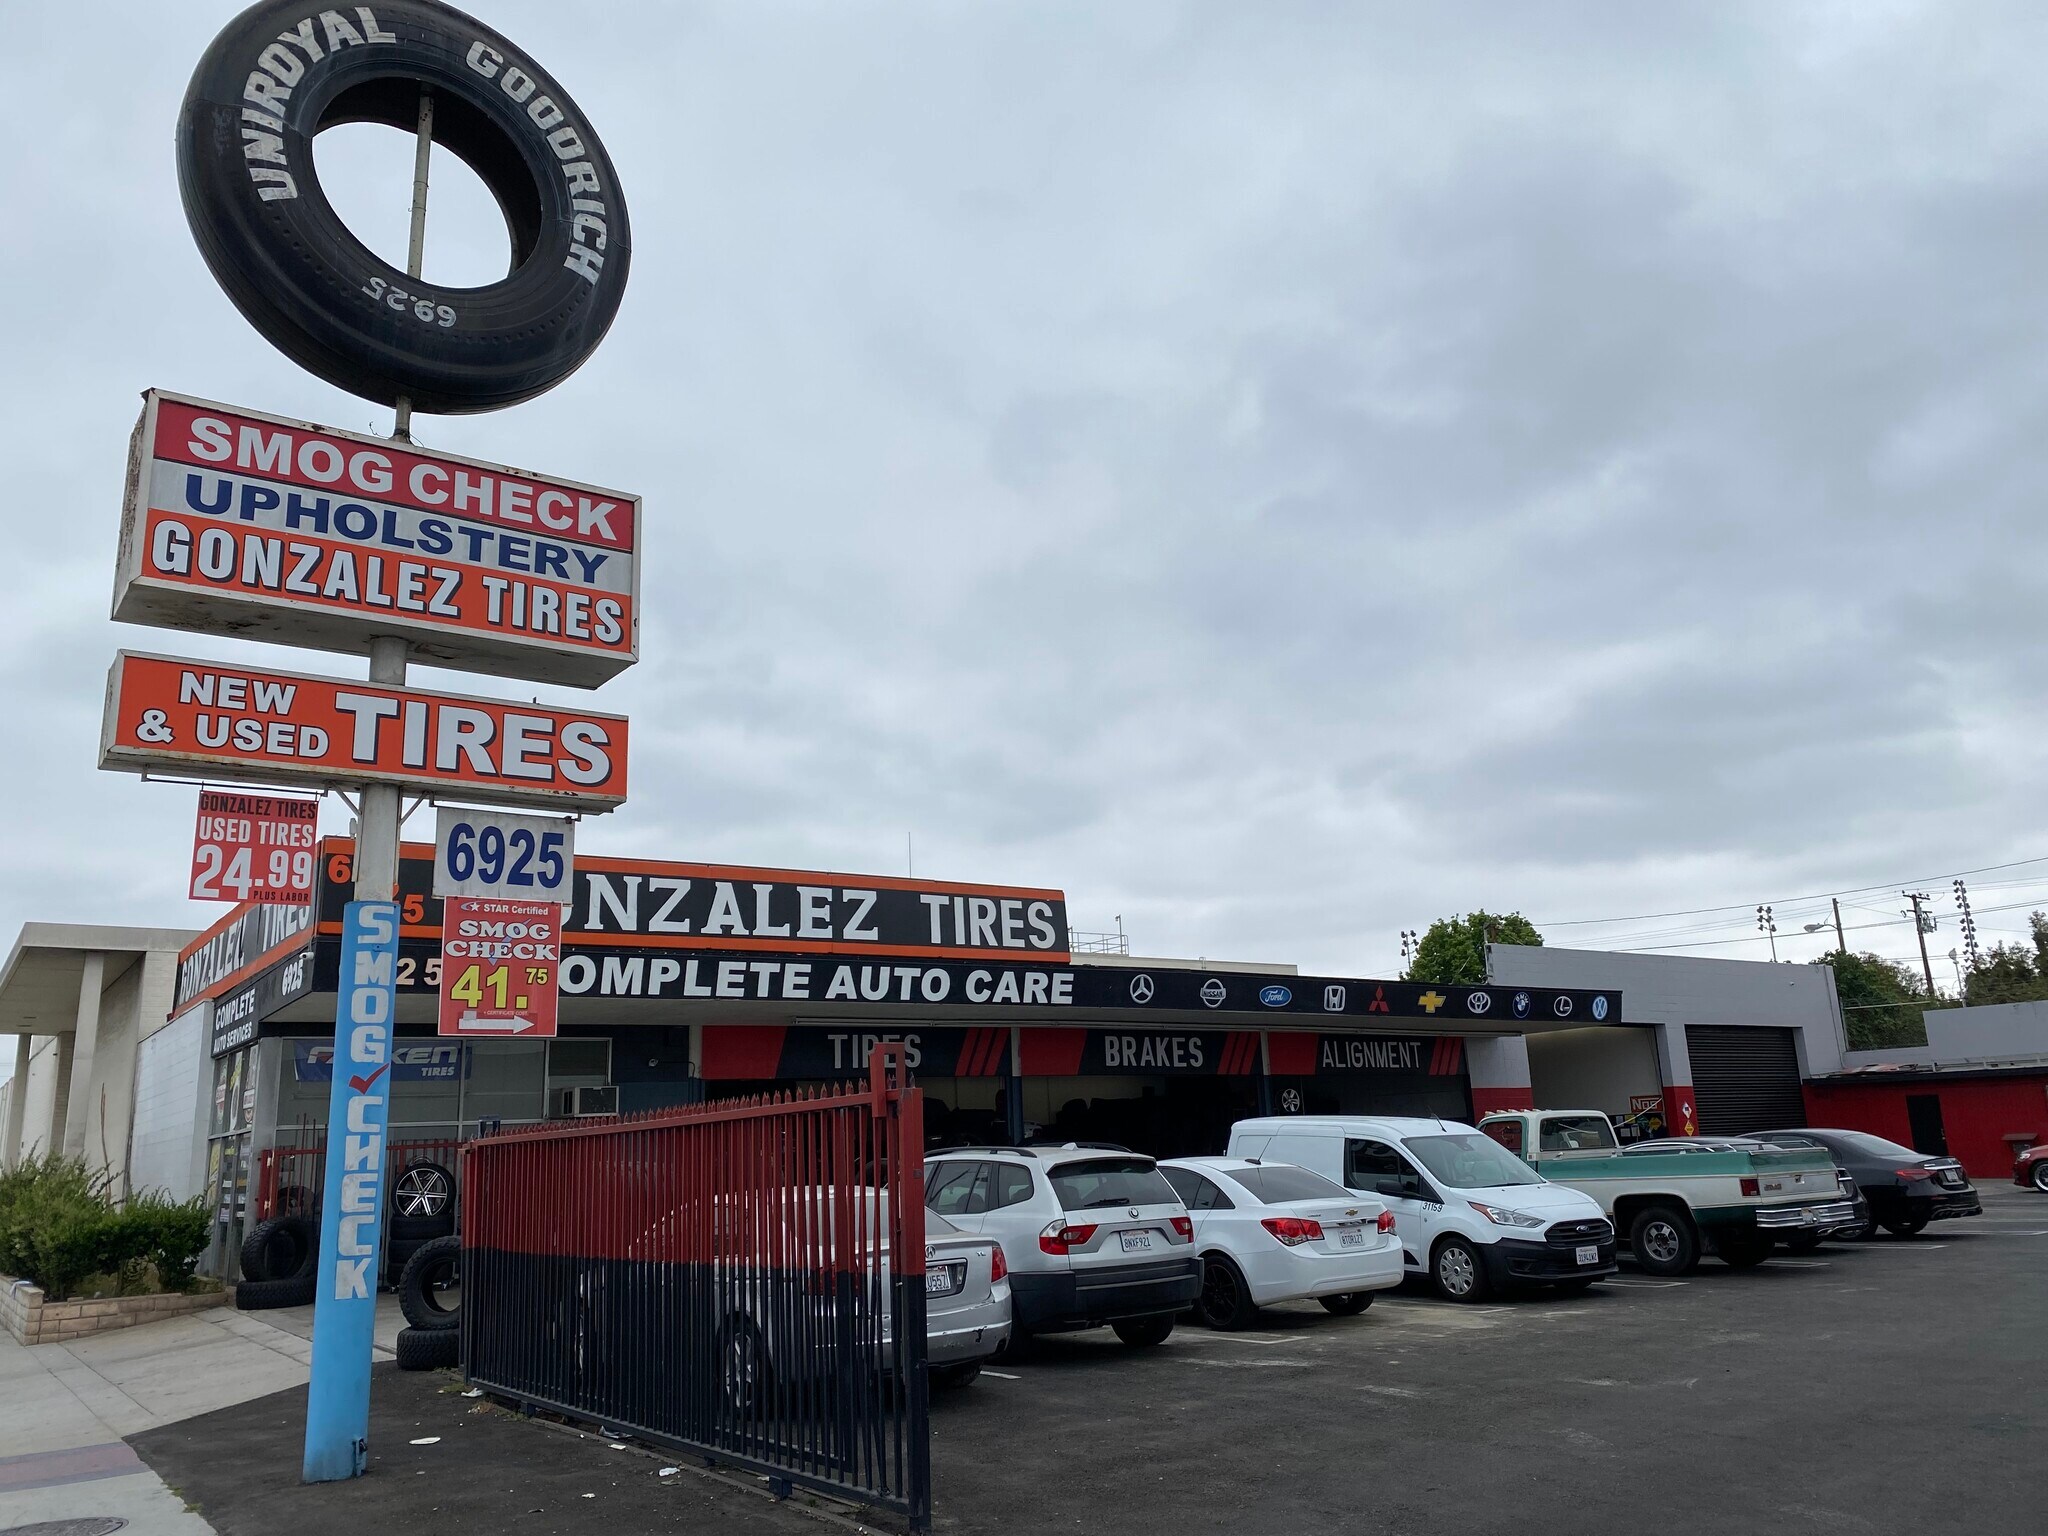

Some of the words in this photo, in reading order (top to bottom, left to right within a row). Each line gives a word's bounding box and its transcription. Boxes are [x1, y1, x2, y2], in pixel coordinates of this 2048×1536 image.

[241, 6, 396, 201] UNIROYAL
[466, 39, 606, 285] GOODRICH
[188, 416, 393, 494] SMOG
[408, 464, 617, 541] CHECK
[185, 474, 610, 584] UPHOLSTERY
[151, 520, 461, 618] GONZALEZ
[482, 574, 625, 646] TIRES
[179, 670, 297, 715] NEW
[135, 708, 175, 745] &
[195, 713, 329, 759] USED
[334, 691, 613, 787] TIRES
[200, 793, 272, 815] GONZALEZ
[277, 801, 317, 819] TIRES
[199, 816, 251, 843] USED
[258, 821, 313, 847] TIRES
[192, 843, 313, 900] 24.99
[446, 822, 565, 889] 6925
[253, 890, 276, 901] PLUS
[280, 891, 309, 902] LABOR
[483, 903, 509, 913] STAR
[511, 905, 549, 916] Certified
[458, 919, 552, 940] SMOG
[920, 894, 1056, 949] TIRES
[179, 912, 247, 1004] GONZALEZ
[444, 940, 558, 961] CHECK
[281, 958, 304, 996] 6925
[349, 905, 395, 1064] SMOG
[558, 954, 812, 1000] OMPLETE
[825, 965, 951, 1001] AUTO
[966, 969, 1074, 1005] CARE
[1264, 990, 1284, 1002] Ford
[215, 988, 256, 1031] COMPLETE
[213, 1034, 227, 1053] AUTO
[226, 1021, 253, 1048] SERVICES
[1104, 1035, 1204, 1069] BRAKES
[1322, 1041, 1422, 1070] ALIGNMENT
[421, 1067, 455, 1077] TIRES
[335, 1096, 384, 1300] CHECK
[1422, 1201, 1443, 1213] 31159
[1124, 1236, 1152, 1249] 8NXF921
